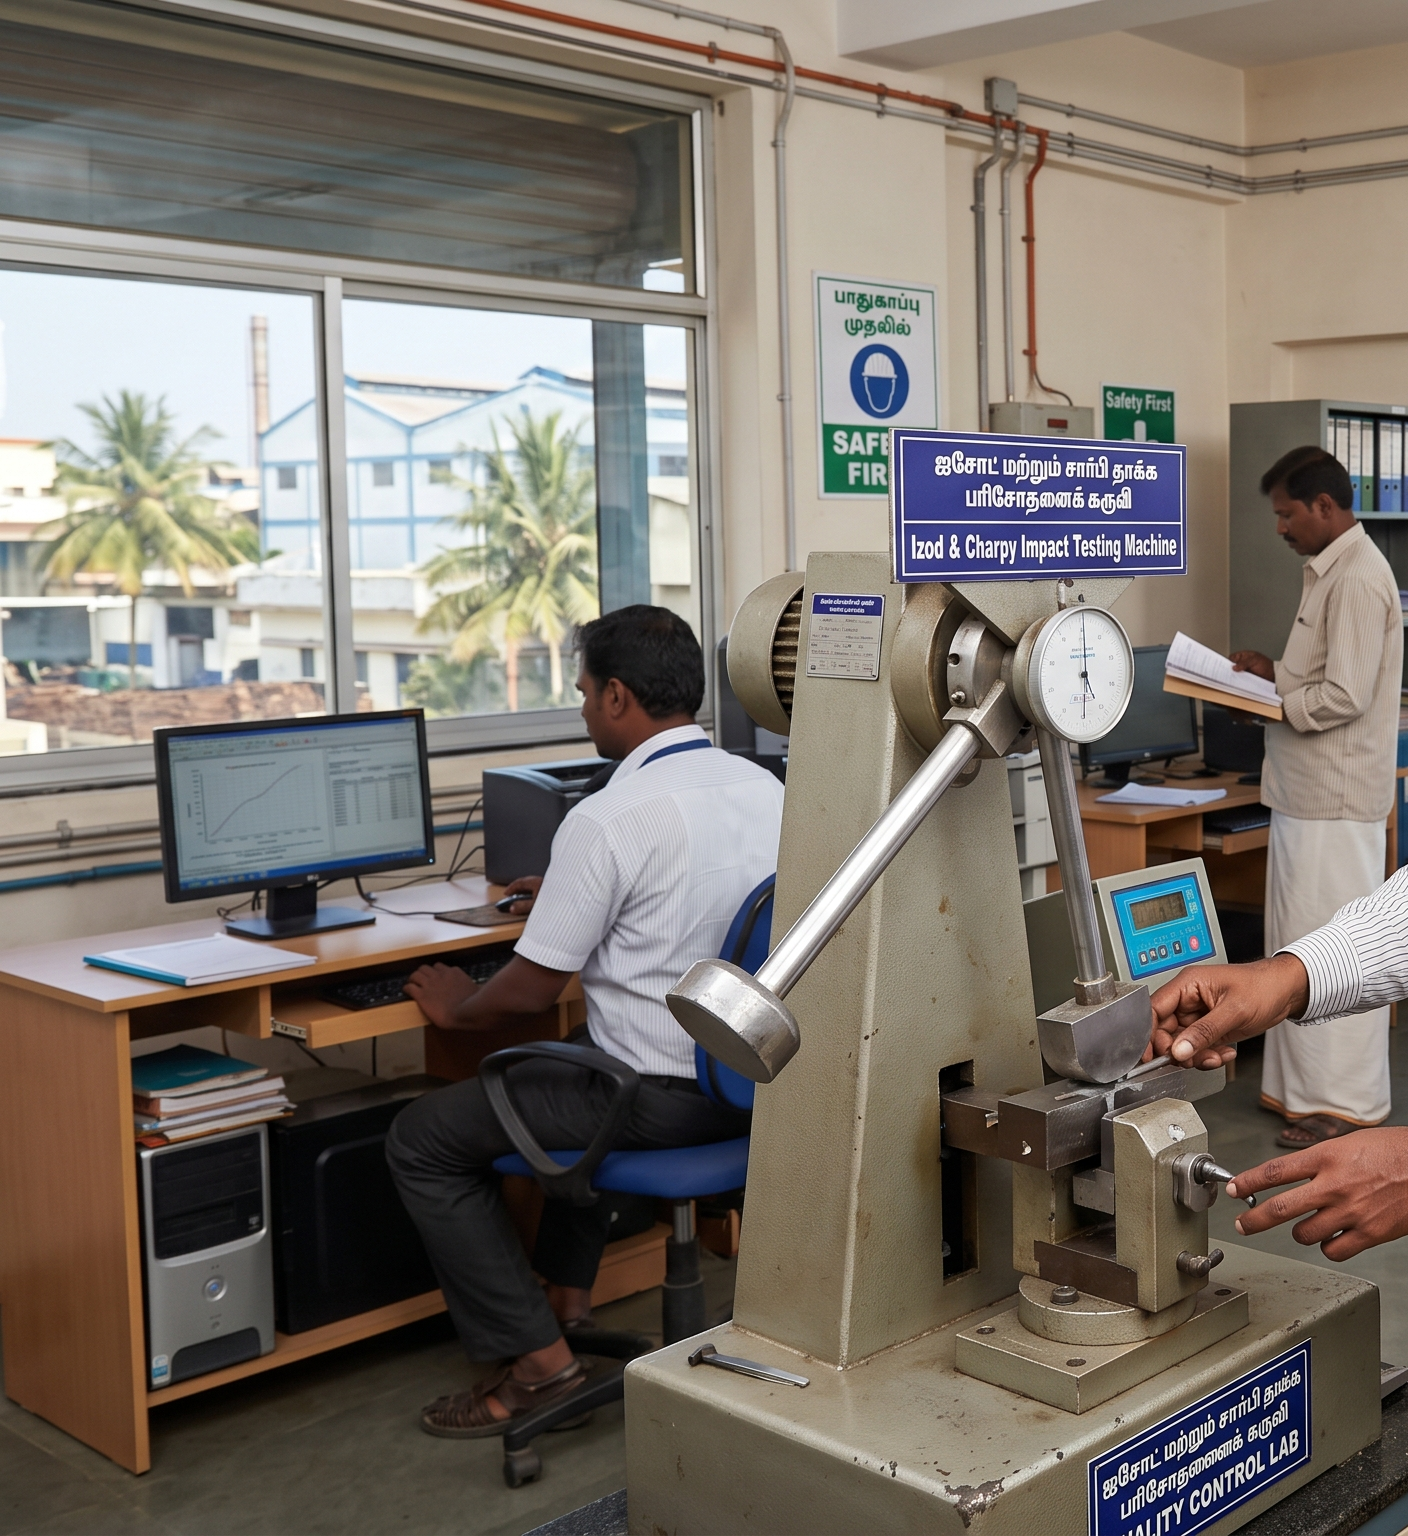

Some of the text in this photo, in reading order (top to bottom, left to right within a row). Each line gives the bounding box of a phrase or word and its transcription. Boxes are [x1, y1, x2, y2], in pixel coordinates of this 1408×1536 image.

[834, 290, 920, 317] பாதுகாப்பு
[844, 314, 912, 339] முதலில்
[1105, 390, 1172, 414] Safety First
[934, 450, 1158, 487] ஐசோட் மற்றும் சார்பி தாக்க
[965, 482, 1132, 516] பரிசோதனைக் கருவி
[911, 533, 1177, 565] Izod & Charpy Impact Testing Machine
[1247, 1399, 1289, 1443] கருவி
[1102, 1447, 1162, 1500] ஐசோட்
[1164, 1413, 1216, 1462] மற்றும்
[1218, 1386, 1261, 1429] சார்பி
[1121, 1429, 1299, 1536] ALITY CONTROL LAB
